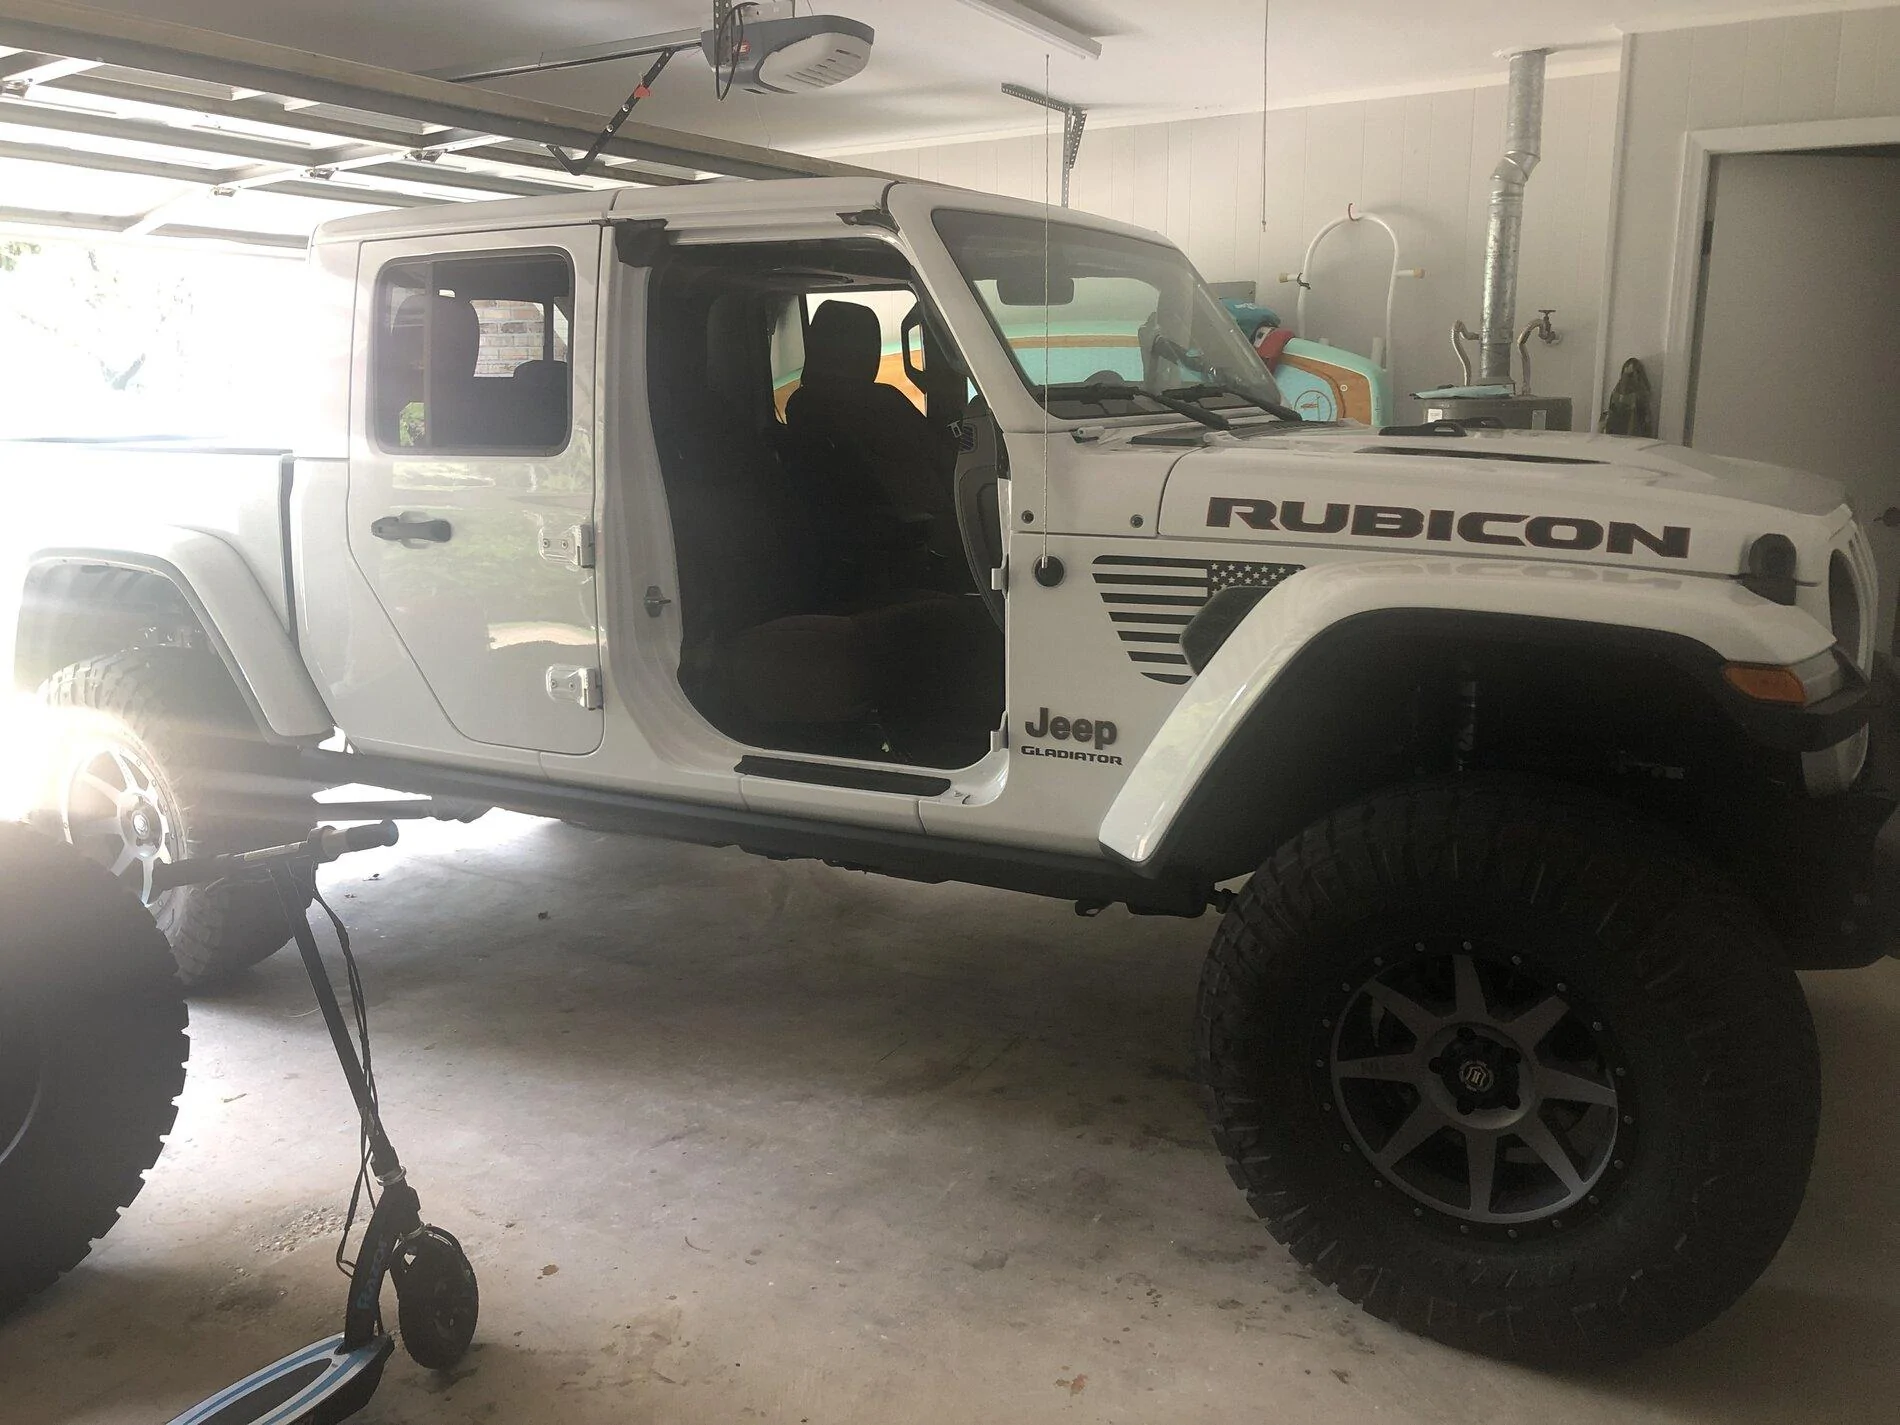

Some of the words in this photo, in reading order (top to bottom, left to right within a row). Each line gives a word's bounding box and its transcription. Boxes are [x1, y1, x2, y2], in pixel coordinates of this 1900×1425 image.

[1206, 496, 1691, 559] RUBICON
[1025, 706, 1118, 750] Jeep
[1021, 745, 1123, 766] GLADIATOR
